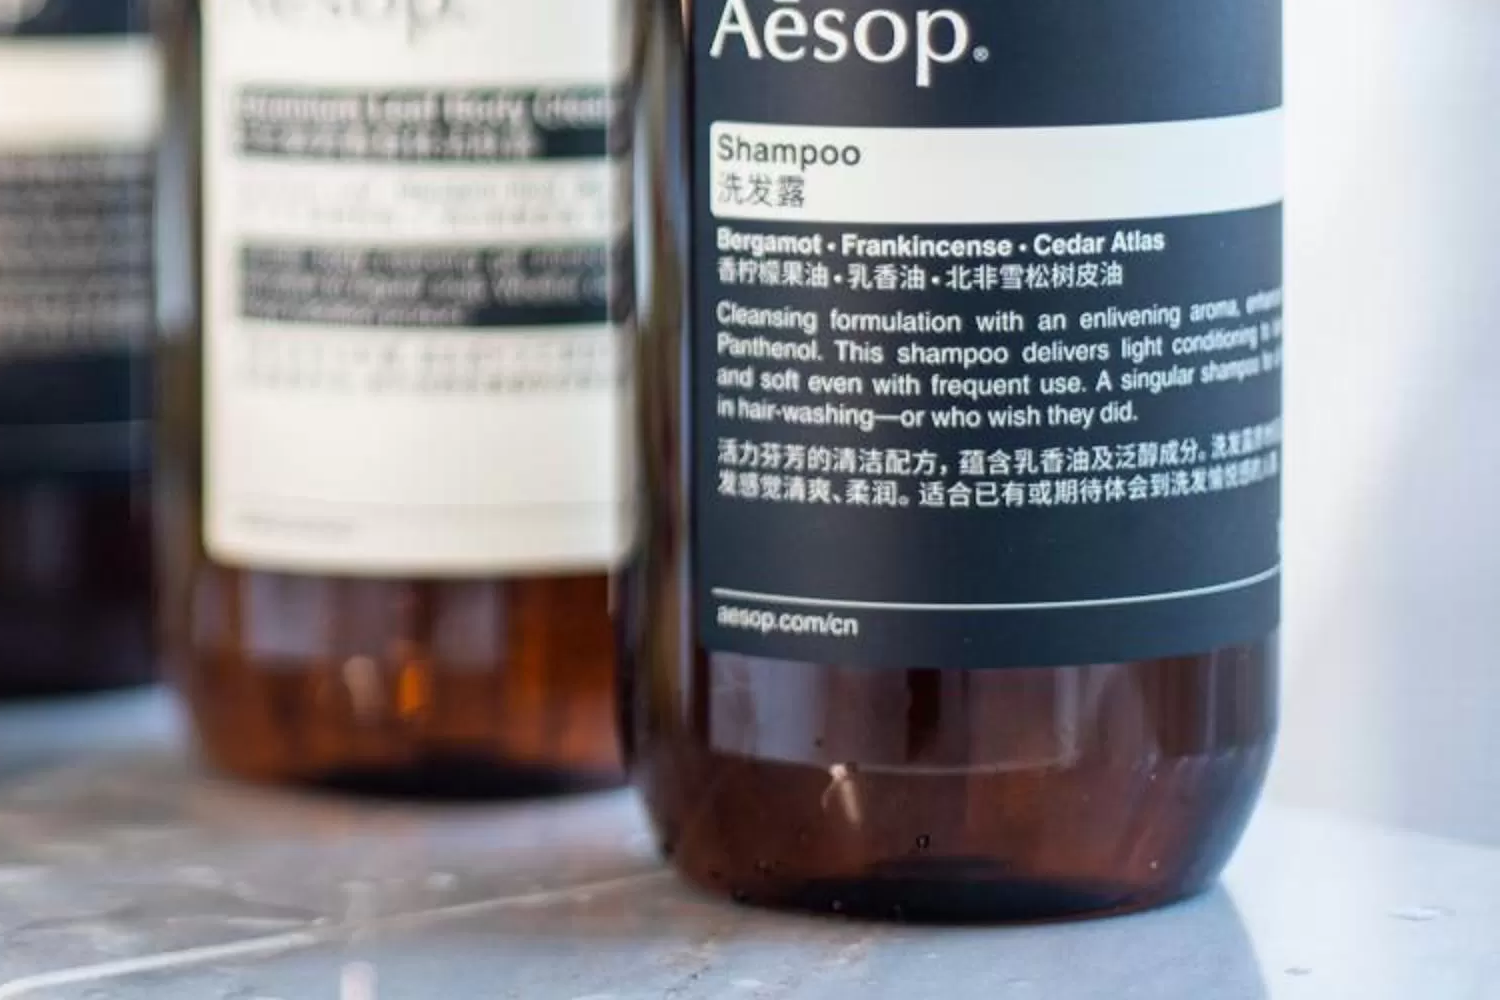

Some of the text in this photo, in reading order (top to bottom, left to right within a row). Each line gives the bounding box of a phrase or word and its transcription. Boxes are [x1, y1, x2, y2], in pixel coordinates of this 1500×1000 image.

[718, 133, 862, 173] Shampoo
[717, 172, 805, 209] 洗发露
[716, 226, 1166, 258] Bergamot Frankincense Cedar Atlas
[716, 300, 819, 336] Cleansing
[829, 307, 962, 333] formulation
[975, 310, 1024, 332] with
[1037, 313, 1067, 332] an
[1079, 303, 1182, 330] enlivening
[717, 331, 823, 362] Panthenol.
[833, 339, 885, 364] This
[896, 341, 1010, 369] shampoo
[1021, 340, 1110, 364] delivers
[1121, 335, 1163, 364] light
[716, 365, 755, 389] and
[760, 368, 801, 393] soft
[807, 375, 863, 395] even
[871, 373, 921, 396] with
[930, 373, 1031, 401] frequent
[1039, 375, 1087, 395] use.
[1095, 369, 1113, 392] A
[1120, 363, 1196, 395] singular
[717, 395, 736, 417] in
[930, 405, 982, 428] who
[987, 404, 1041, 428] wish
[1047, 403, 1095, 430] they
[1099, 399, 1138, 424] did.
[717, 605, 859, 636] aesop.com/cn
